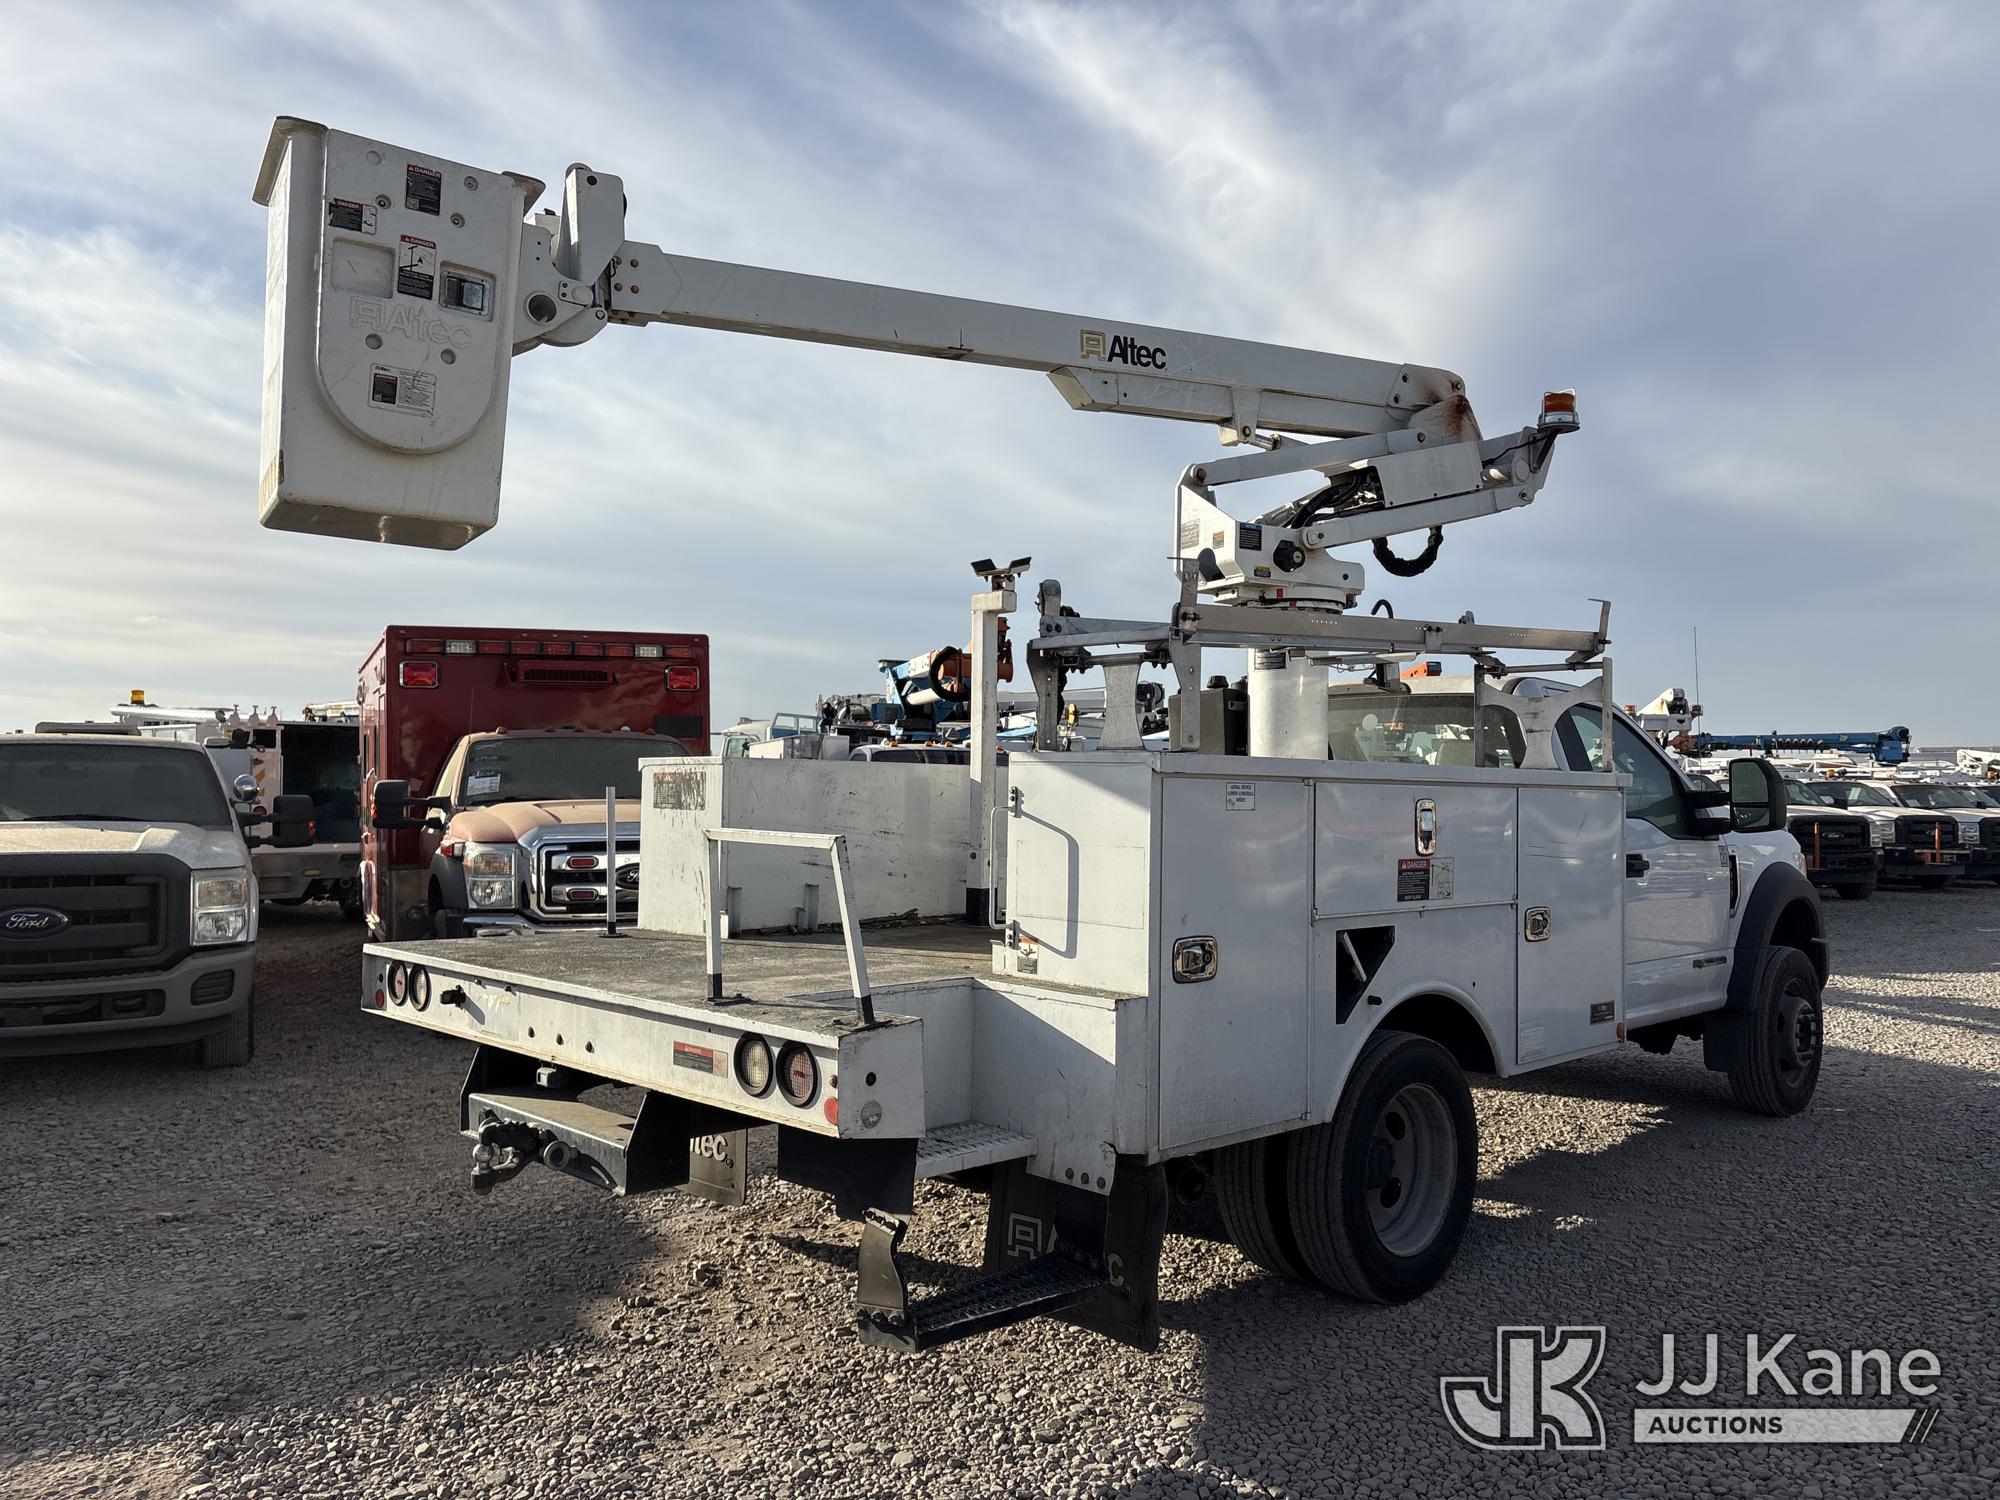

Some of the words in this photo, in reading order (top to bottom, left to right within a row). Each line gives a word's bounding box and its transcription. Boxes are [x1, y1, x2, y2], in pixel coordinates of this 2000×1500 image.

[414, 166, 441, 178] DANGER
[337, 201, 360, 209] DANGER
[411, 238, 434, 248] DANGER
[385, 303, 472, 350] Altec
[1107, 334, 1167, 370] Altec
[1406, 860, 1427, 869] DANGER
[6, 913, 49, 929] Ford
